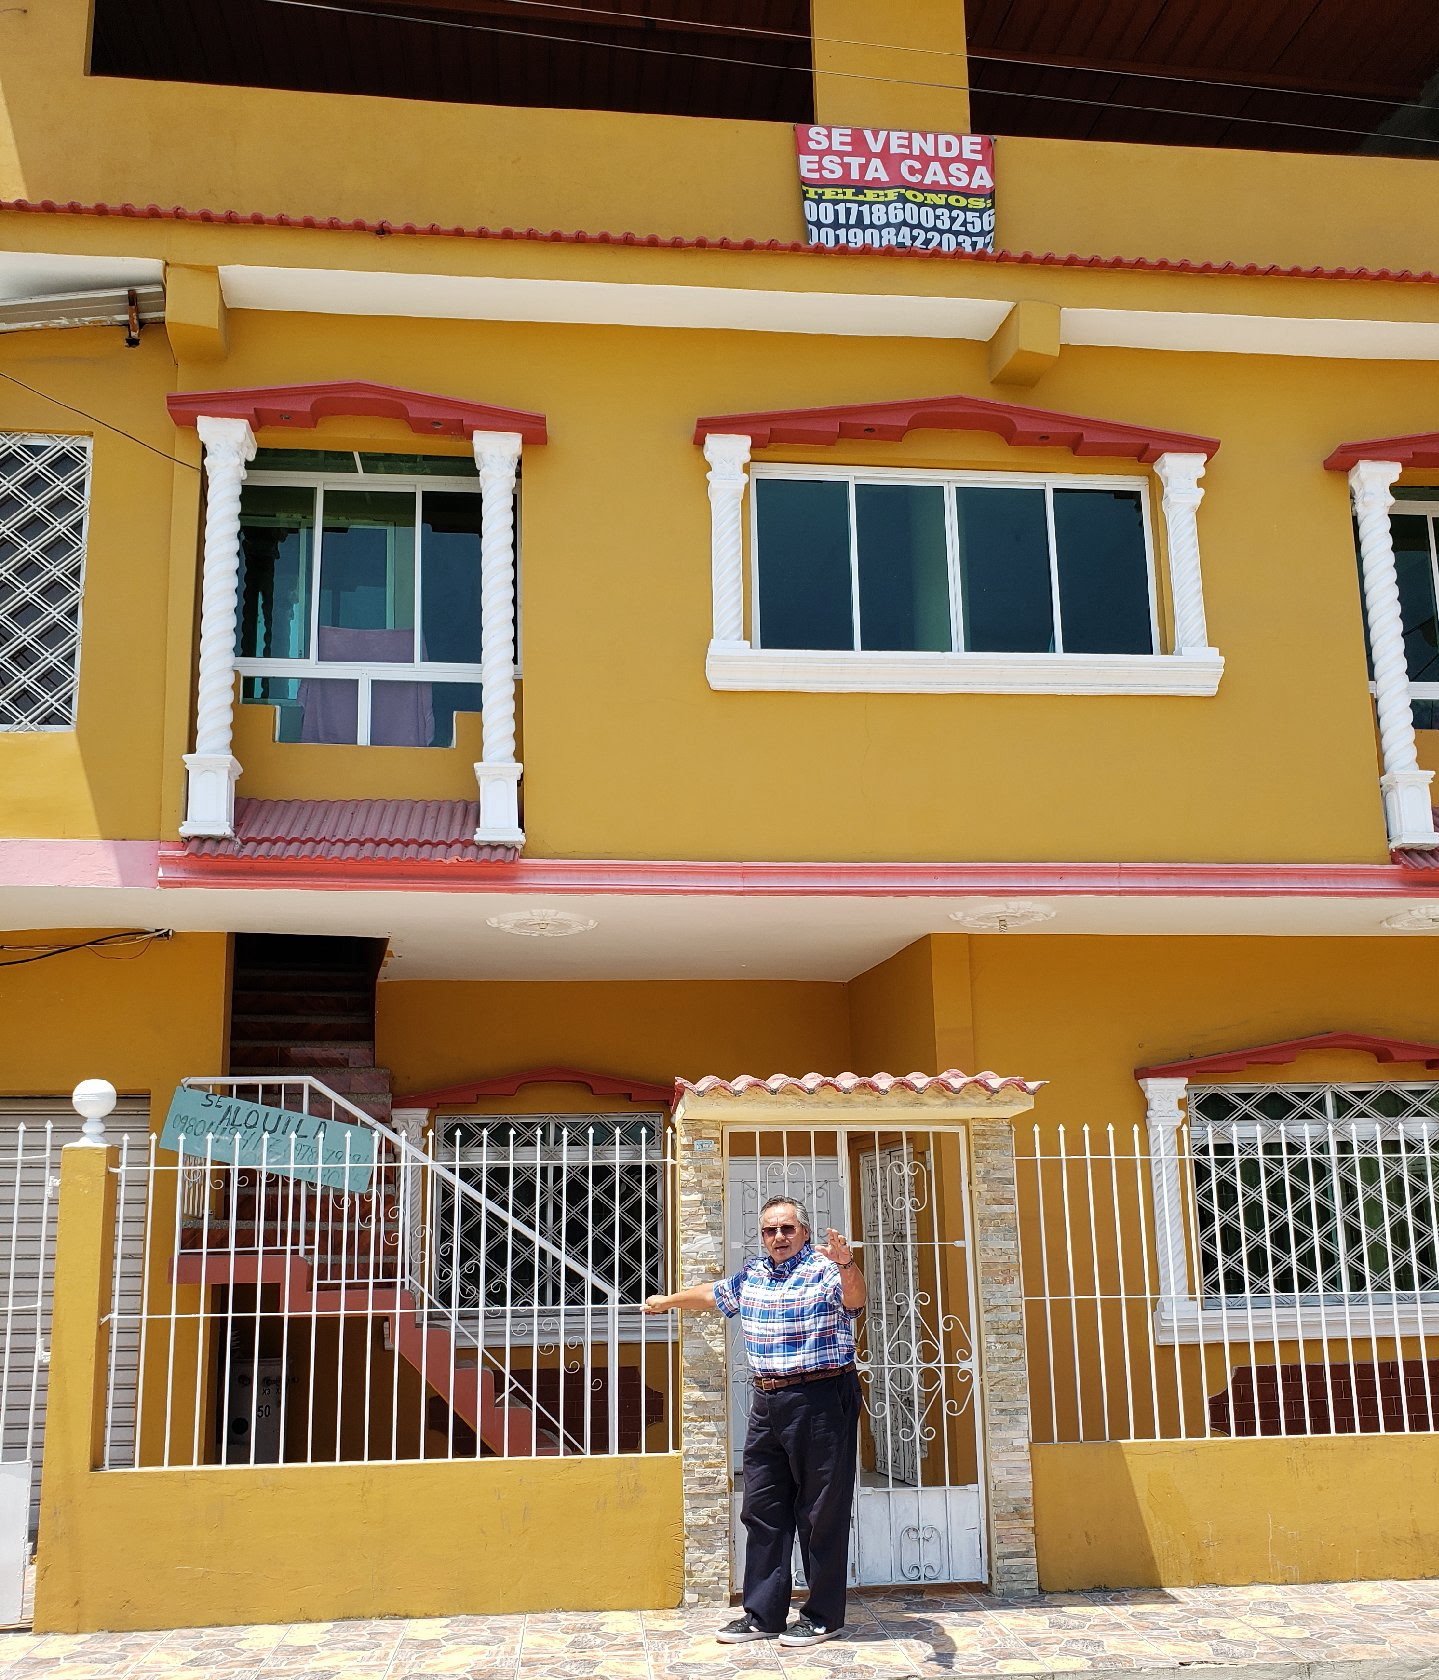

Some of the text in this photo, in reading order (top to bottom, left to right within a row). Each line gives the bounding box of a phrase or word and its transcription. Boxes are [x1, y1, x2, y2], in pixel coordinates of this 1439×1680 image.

[807, 126, 983, 161] SE VENDE
[799, 154, 994, 189] ESTA CASA
[801, 184, 993, 209] TELEFONOS:
[803, 200, 996, 233] 0017186003256
[201, 1094, 224, 1109] SE
[219, 1104, 328, 1144] ALQUILA
